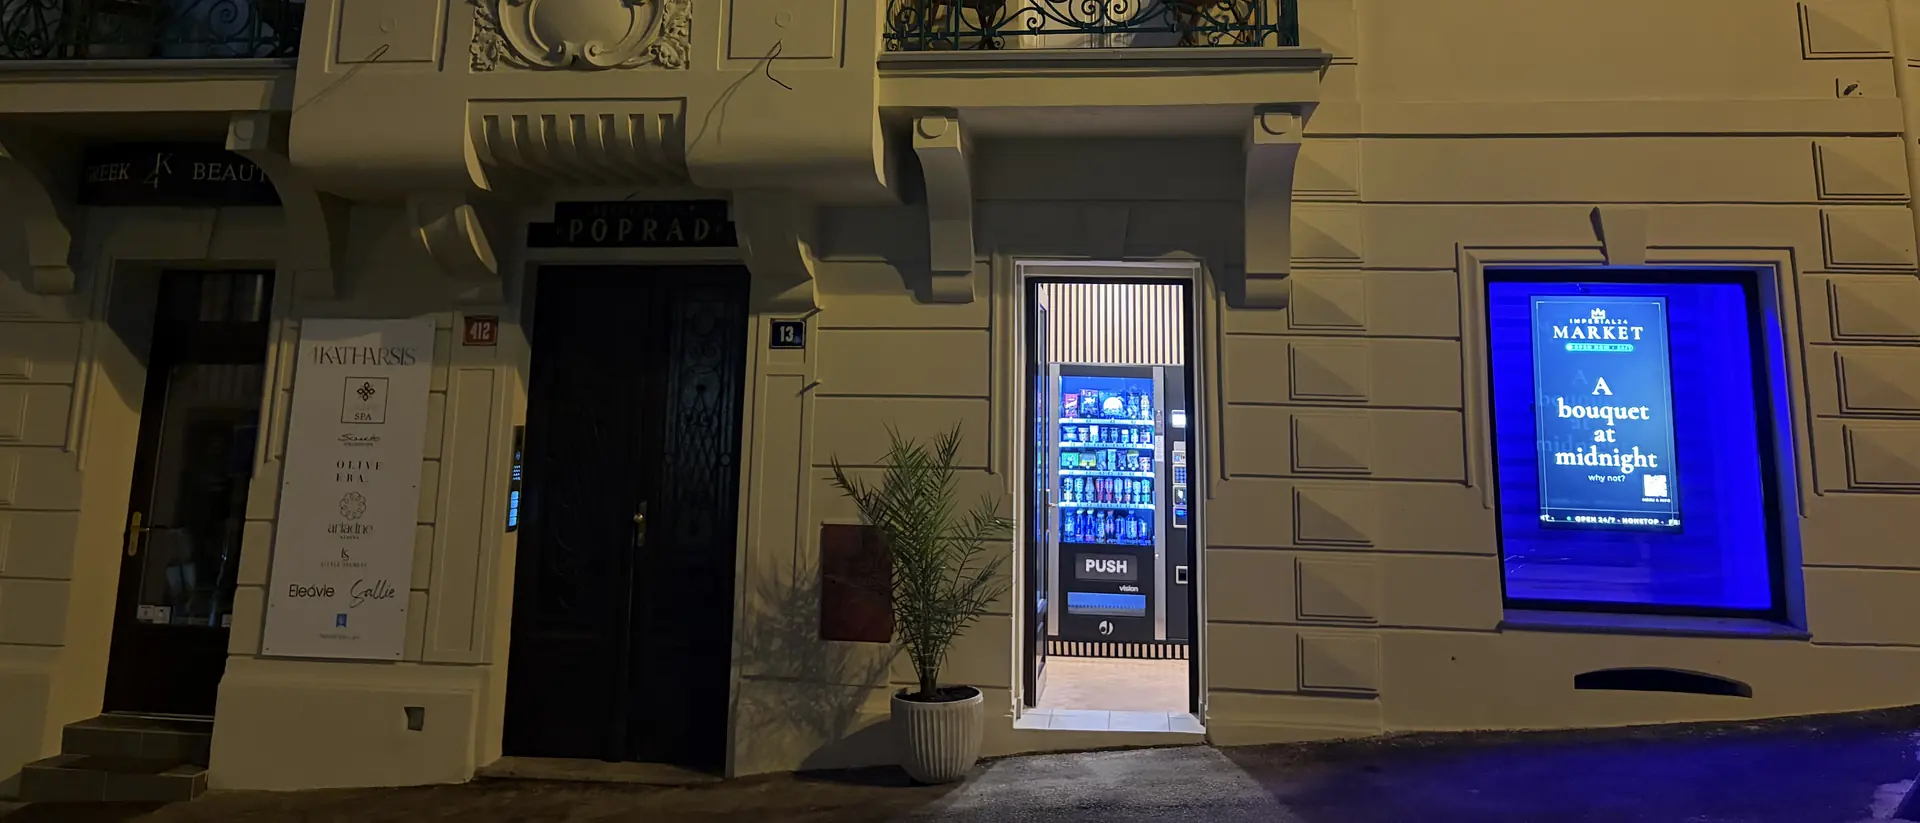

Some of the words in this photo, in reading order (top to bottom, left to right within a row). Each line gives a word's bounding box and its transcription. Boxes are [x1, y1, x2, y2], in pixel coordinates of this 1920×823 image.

[568, 217, 711, 243] POPRAD
[470, 322, 490, 340] 412
[1552, 325, 1644, 340] MARKET
[1592, 377, 1613, 396] A
[354, 412, 372, 421] SPA
[1557, 397, 1650, 426] bouquet
[1594, 428, 1616, 443] at
[1555, 445, 1658, 474] midnight
[1588, 474, 1606, 483] why
[1607, 474, 1626, 483] not?
[1575, 515, 1597, 524] OPEN
[1598, 515, 1616, 525] 24/7
[1085, 559, 1128, 573] PUSH
[350, 578, 396, 609] Sallie
[1119, 584, 1139, 593] vision
